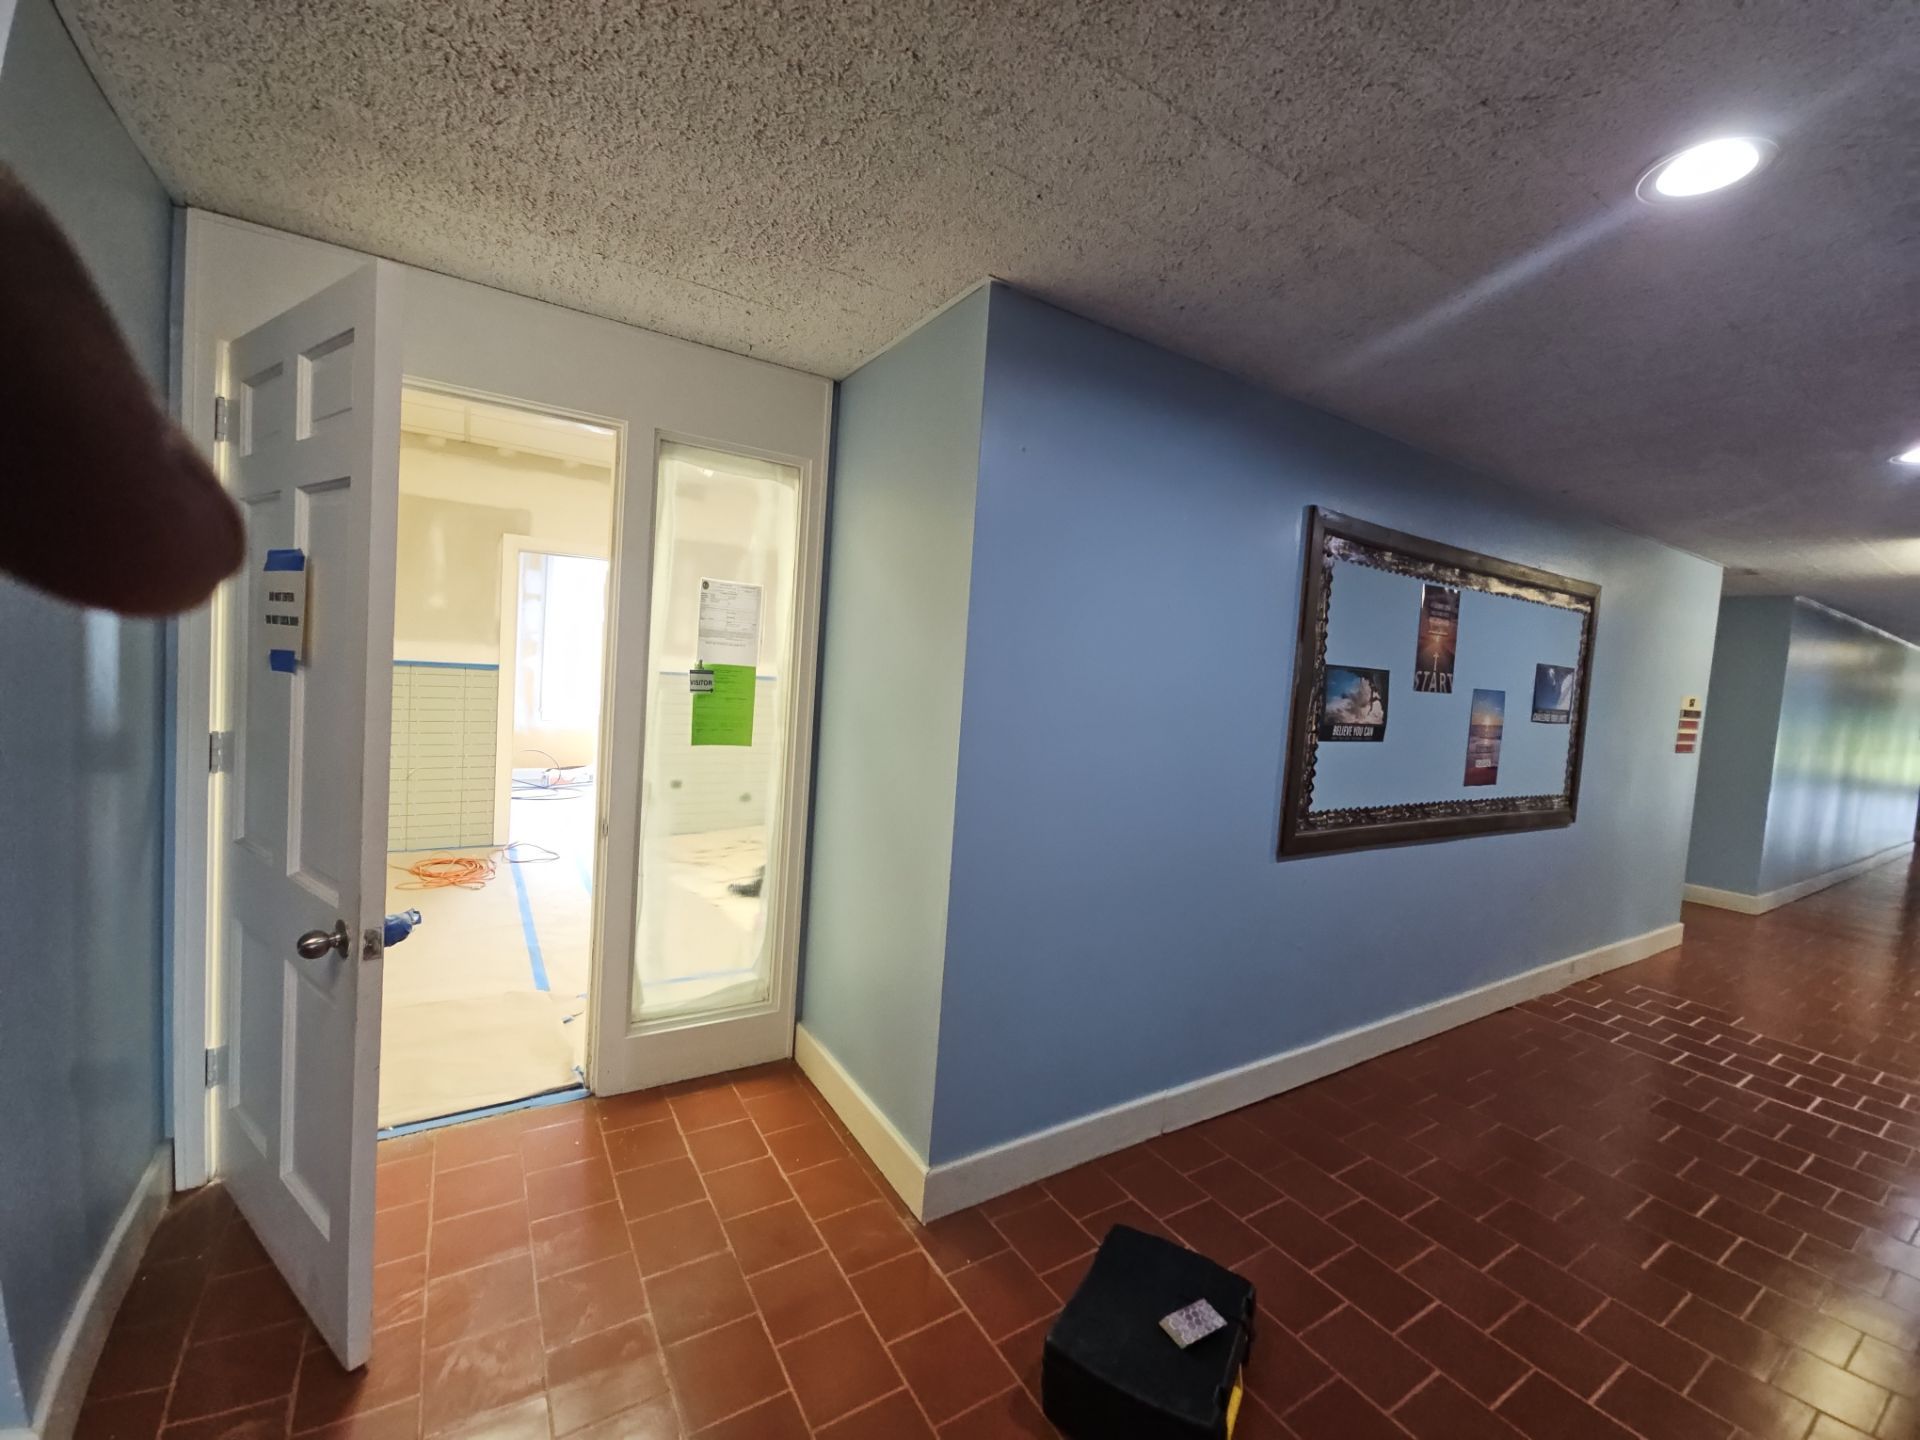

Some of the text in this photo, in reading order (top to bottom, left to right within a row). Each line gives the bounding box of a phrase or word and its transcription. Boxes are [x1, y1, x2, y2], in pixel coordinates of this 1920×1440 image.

[1414, 671, 1453, 693] START
[1332, 725, 1374, 737] BELIEVE YOU CAN
